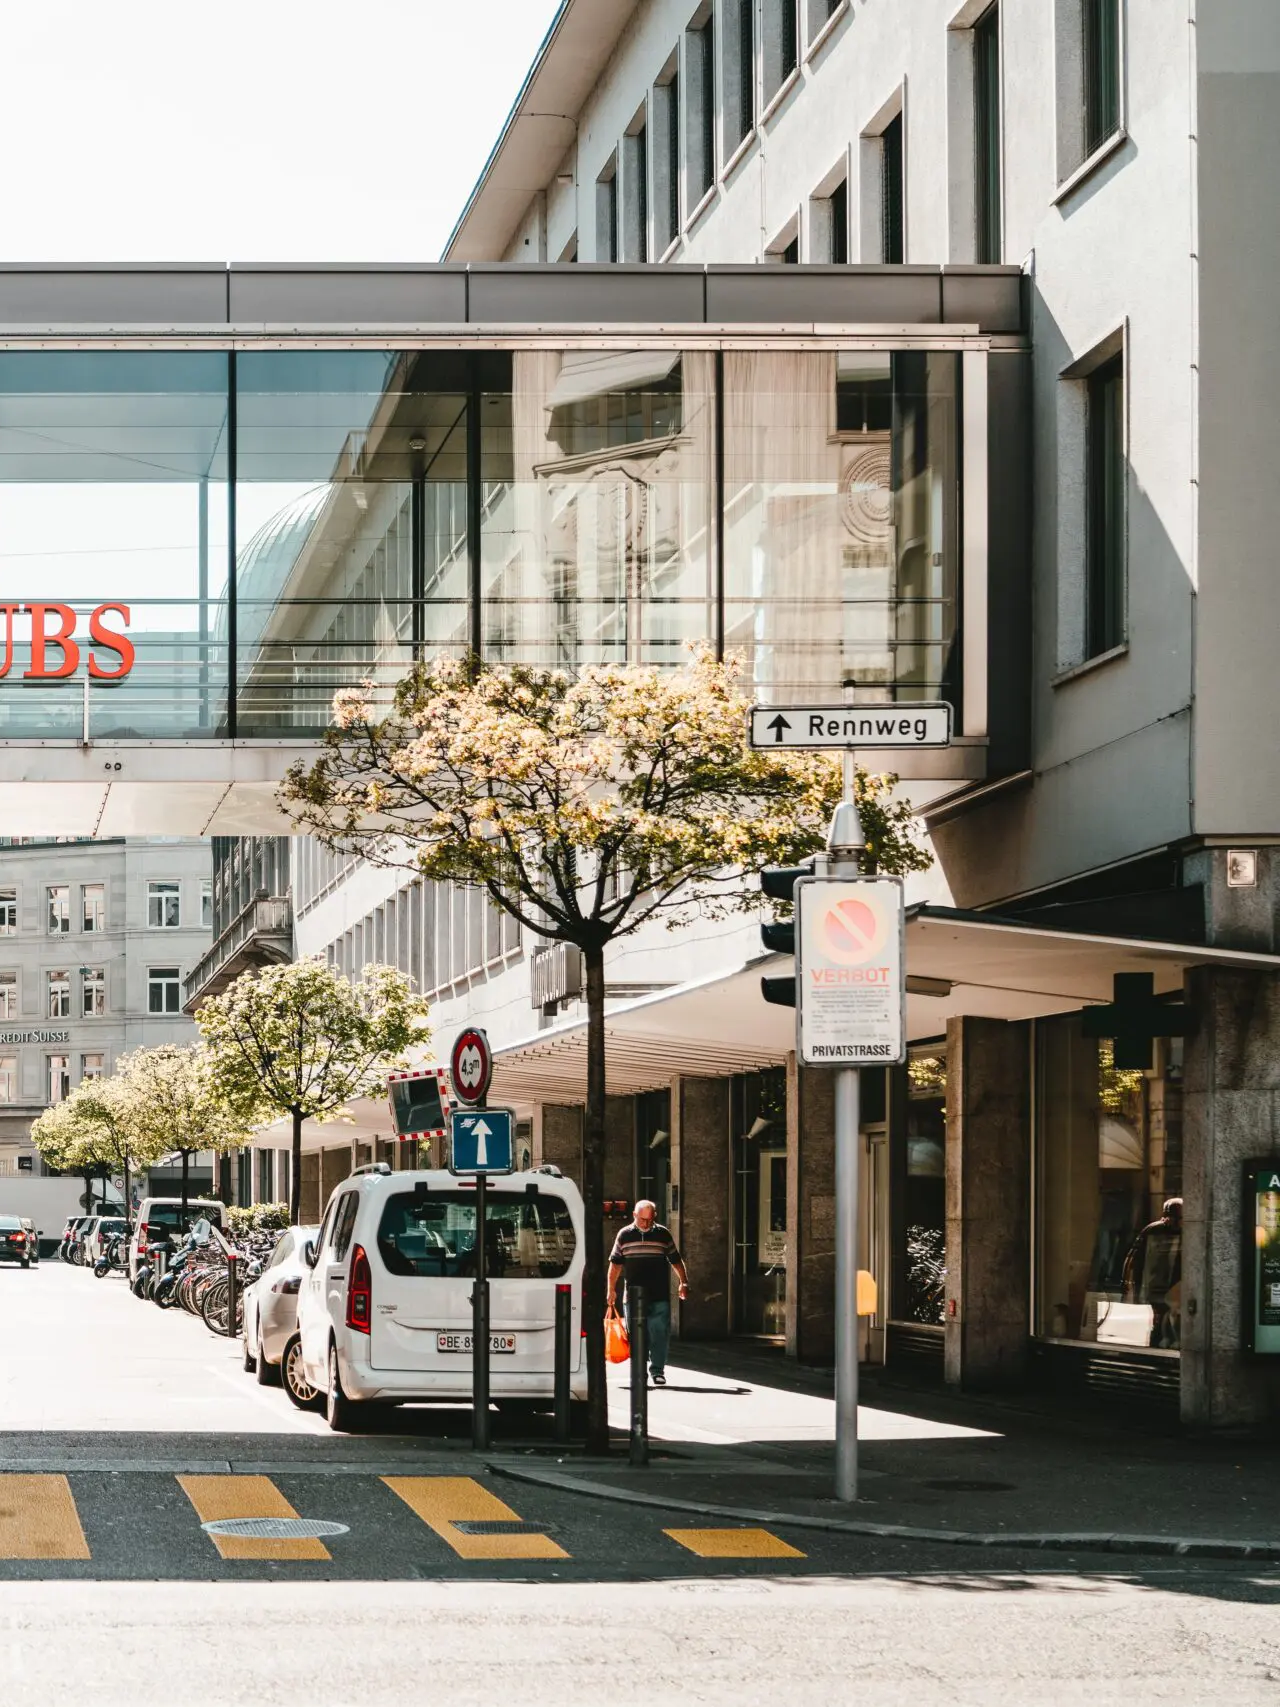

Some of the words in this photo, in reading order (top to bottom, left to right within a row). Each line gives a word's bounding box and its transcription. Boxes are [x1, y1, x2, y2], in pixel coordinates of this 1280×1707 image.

[809, 714, 927, 741] Rennweg
[810, 967, 890, 983] VERBOT
[31, 1029, 70, 1043] SUISSE
[812, 1044, 892, 1057] PRIVATSTRASSE
